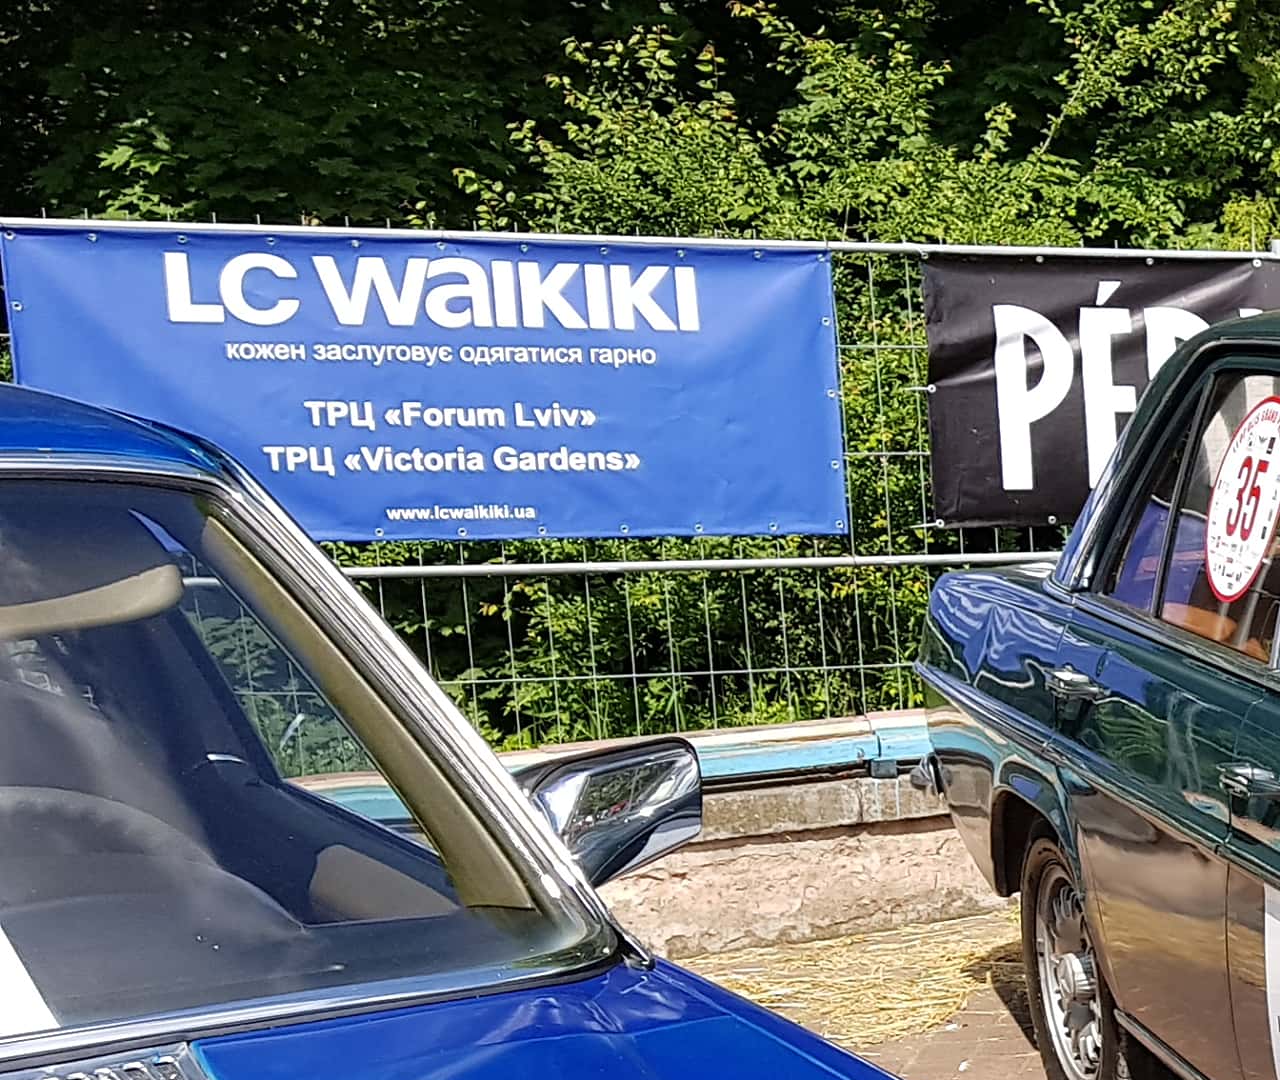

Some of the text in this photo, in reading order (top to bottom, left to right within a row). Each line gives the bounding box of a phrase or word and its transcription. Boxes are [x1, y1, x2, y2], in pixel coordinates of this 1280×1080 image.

[164, 252, 301, 327] LC
[226, 342, 656, 368] кожен заслуговує одягатися гарно
[303, 401, 597, 431] ТРЦ «Forum Lviv»
[262, 446, 641, 477] ТРЦ «Victoria Gardens»
[385, 505, 537, 521] www.lcwaikiki.ua
[1226, 456, 1270, 542] 35
